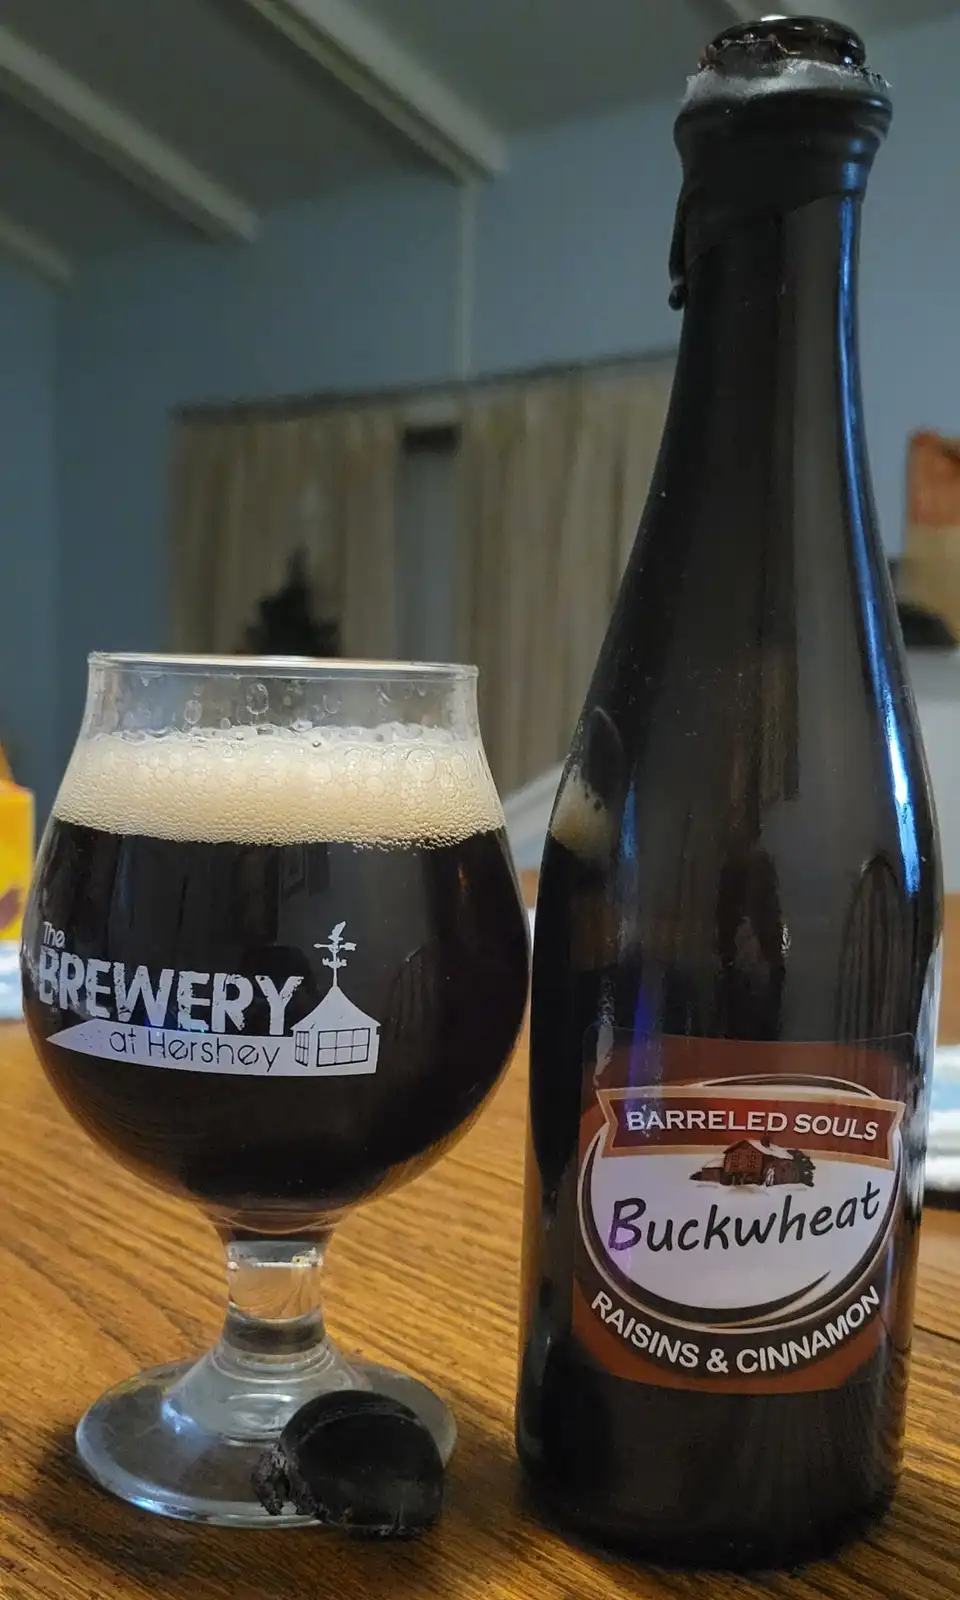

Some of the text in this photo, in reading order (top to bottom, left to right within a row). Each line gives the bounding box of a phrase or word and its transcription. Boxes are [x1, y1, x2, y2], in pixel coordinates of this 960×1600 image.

[43, 921, 65, 948] The
[38, 947, 304, 1035] BREWERY
[109, 1028, 281, 1072] at Hershey
[626, 1109, 879, 1141] BARRELED SOULS
[608, 1181, 881, 1252] Buckwheat
[591, 1285, 881, 1374] RAISINS & CINNAMON
